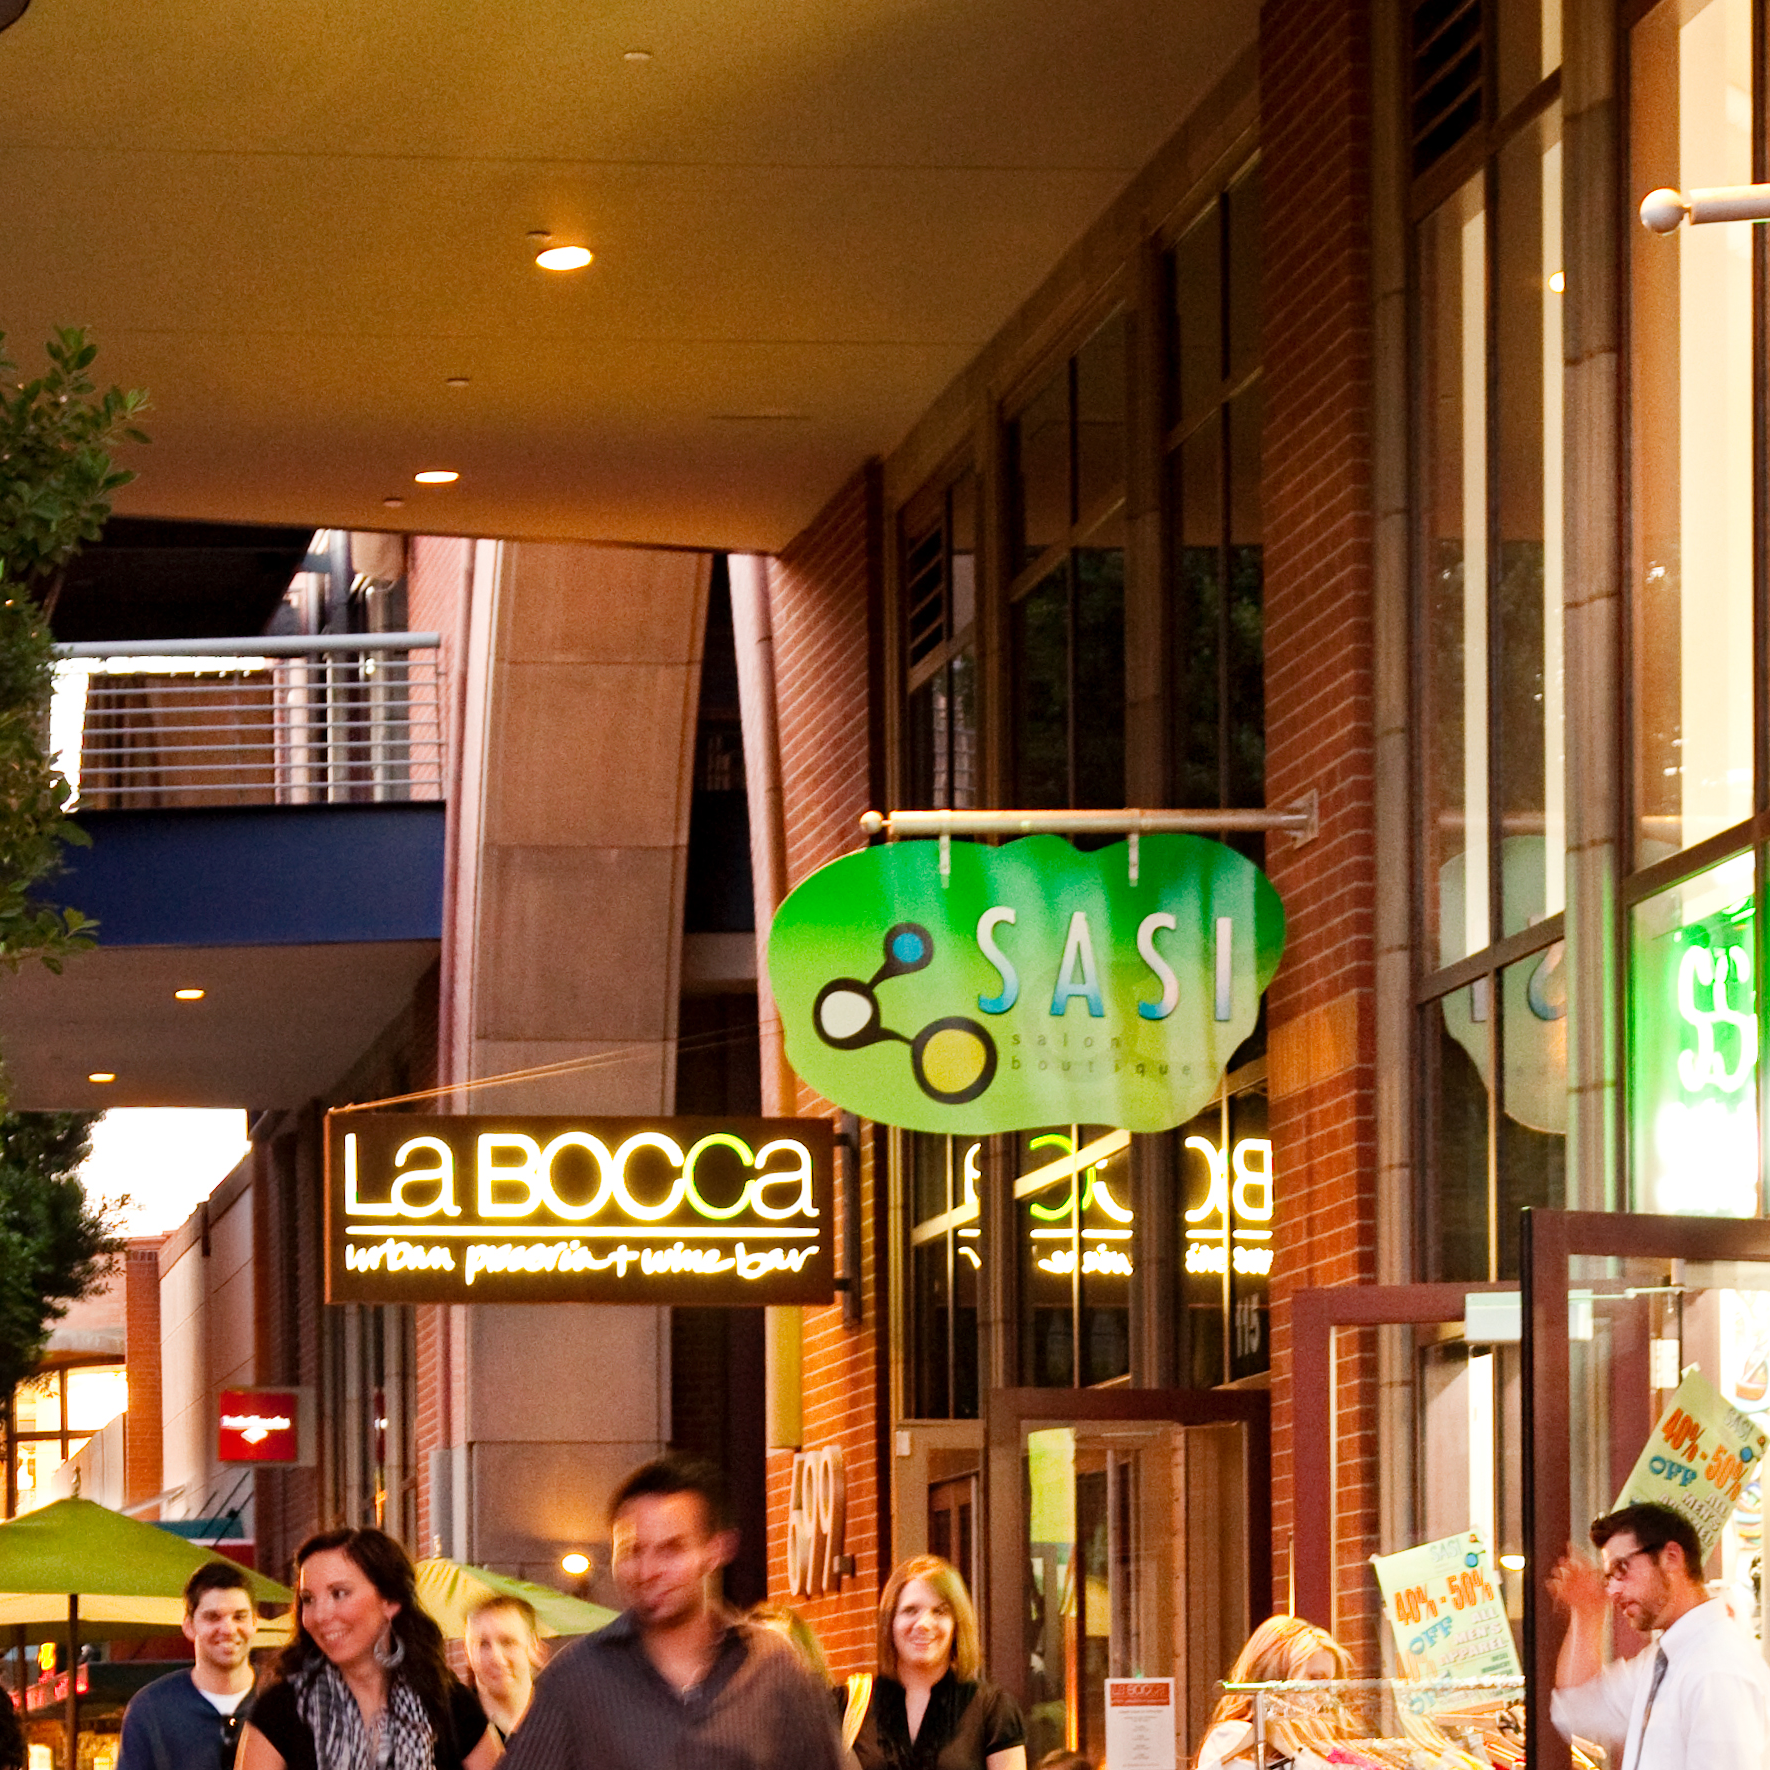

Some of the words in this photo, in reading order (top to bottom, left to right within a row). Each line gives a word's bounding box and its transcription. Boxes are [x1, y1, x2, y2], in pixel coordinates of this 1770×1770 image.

[976, 906, 1233, 1021] SASI
[1011, 1033, 1121, 1049] salon
[1011, 1055, 1191, 1077] boutique
[345, 1238, 456, 1273] urban
[736, 1241, 820, 1280] bar
[1649, 1455, 1698, 1487] OFF
[1394, 1583, 1439, 1626] 40%
[1446, 1566, 1495, 1611] 50%
[1409, 1616, 1452, 1655] OFF
